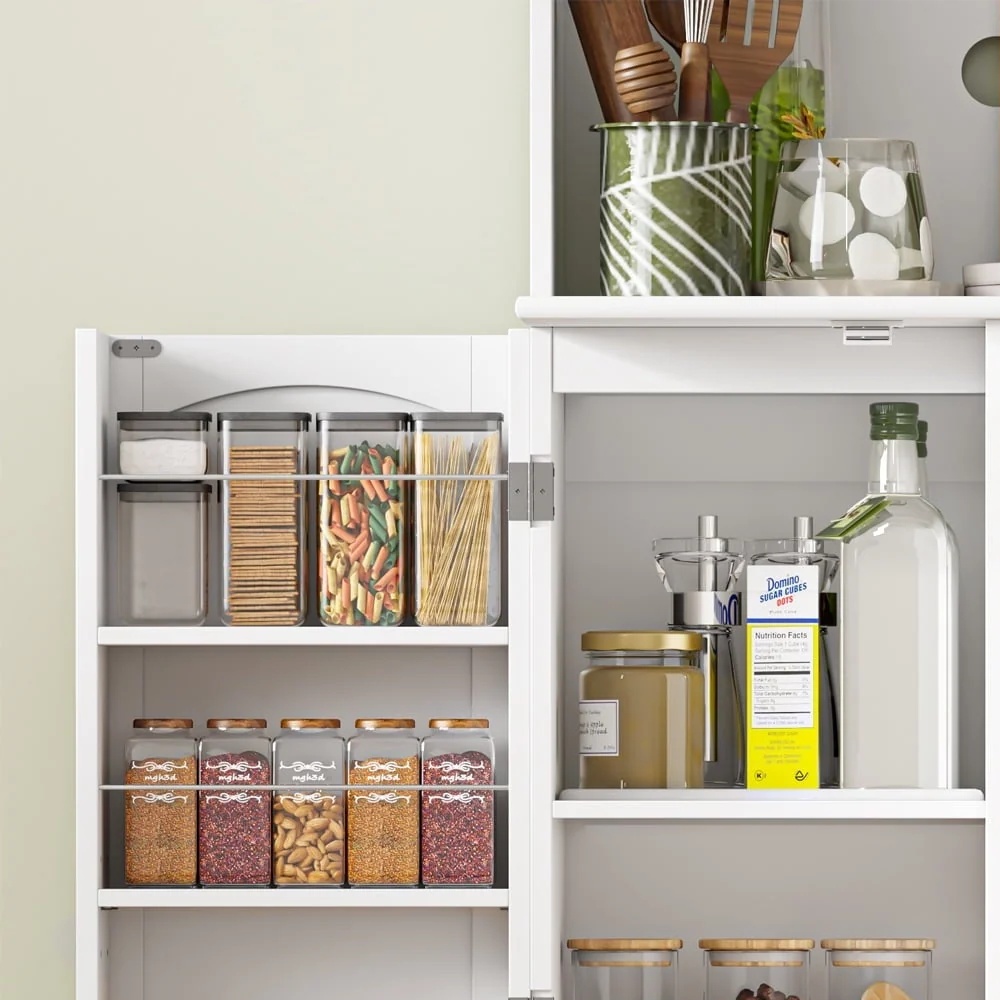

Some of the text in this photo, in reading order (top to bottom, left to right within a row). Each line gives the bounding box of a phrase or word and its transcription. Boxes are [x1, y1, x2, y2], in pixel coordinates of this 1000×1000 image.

[766, 575, 799, 592] Domino
[760, 582, 807, 603] SUGAR CUBES
[755, 631, 808, 639] Nutrition Facts
